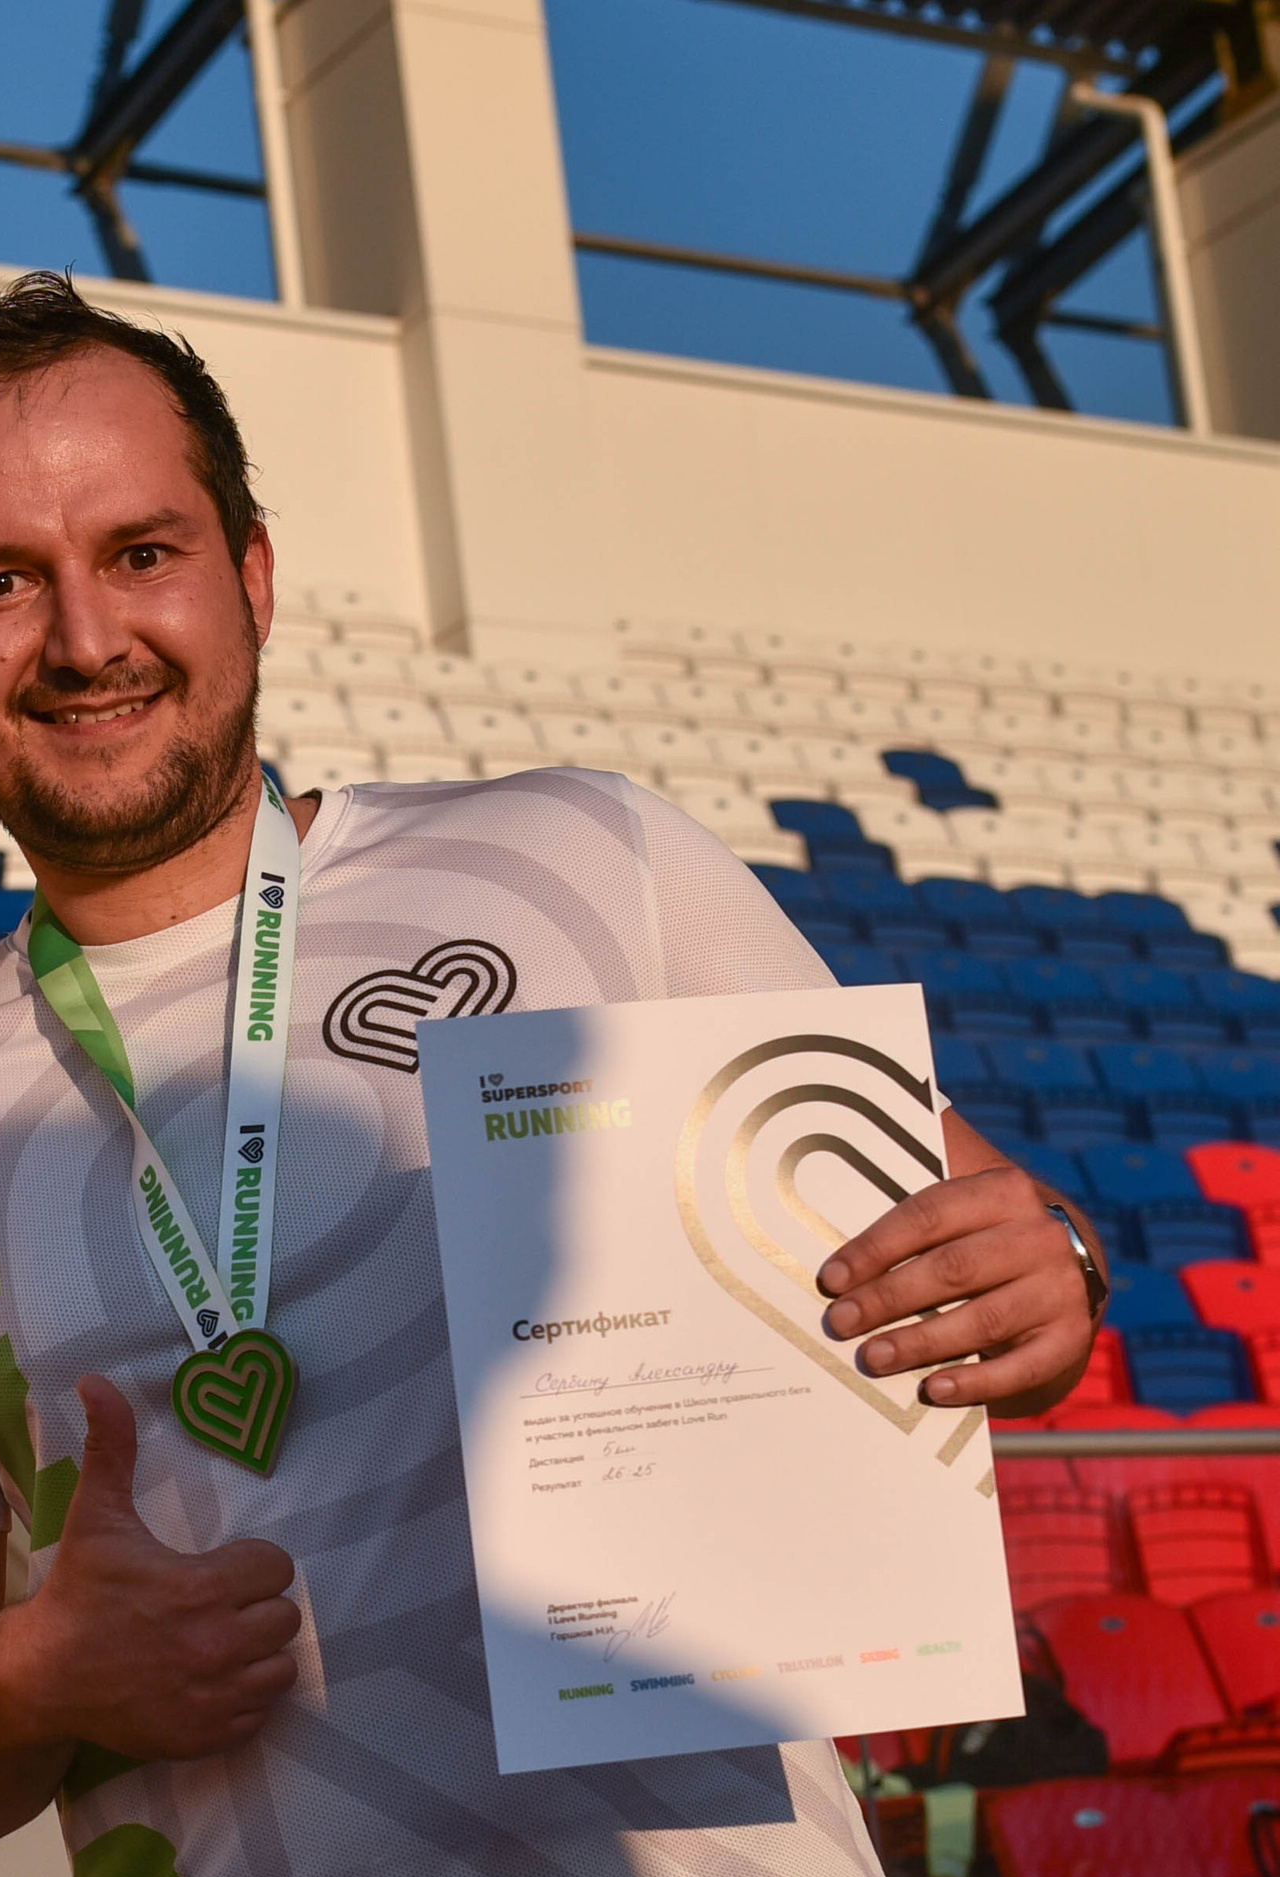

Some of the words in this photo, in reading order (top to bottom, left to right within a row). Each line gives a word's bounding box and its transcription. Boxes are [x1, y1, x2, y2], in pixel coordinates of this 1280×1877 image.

[261, 872, 285, 884] I
[247, 909, 282, 1042] RUNNING
[479, 1075, 486, 1088] I
[481, 1079, 593, 1103] SUPERSPORT
[240, 1124, 265, 1134] I
[485, 1099, 632, 1141] RUNNING
[139, 1164, 211, 1310] RUNNING
[231, 1167, 262, 1323] RUNNING
[512, 1309, 671, 1344] Сертификат
[523, 1416, 557, 1427] выдан
[559, 1414, 570, 1423] за
[573, 1408, 623, 1423] успешное
[624, 1402, 673, 1416] обучение
[683, 1396, 718, 1408] Школе
[720, 1388, 786, 1404] правильного
[788, 1384, 812, 1396] бега
[535, 1431, 575, 1444] участие
[585, 1423, 644, 1437] финальном
[646, 1418, 680, 1429] забеге
[681, 1414, 705, 1425] Love
[707, 1412, 728, 1422] Run
[528, 1455, 585, 1469] Дистанция
[531, 1480, 583, 1493] Результат
[547, 1602, 594, 1614] Директор
[554, 1615, 577, 1625] Love
[578, 1611, 617, 1621] Running
[777, 1654, 844, 1674] TRIATHLON
[558, 1683, 614, 1701] RUNNING
[630, 1673, 695, 1692] SWIMMING
